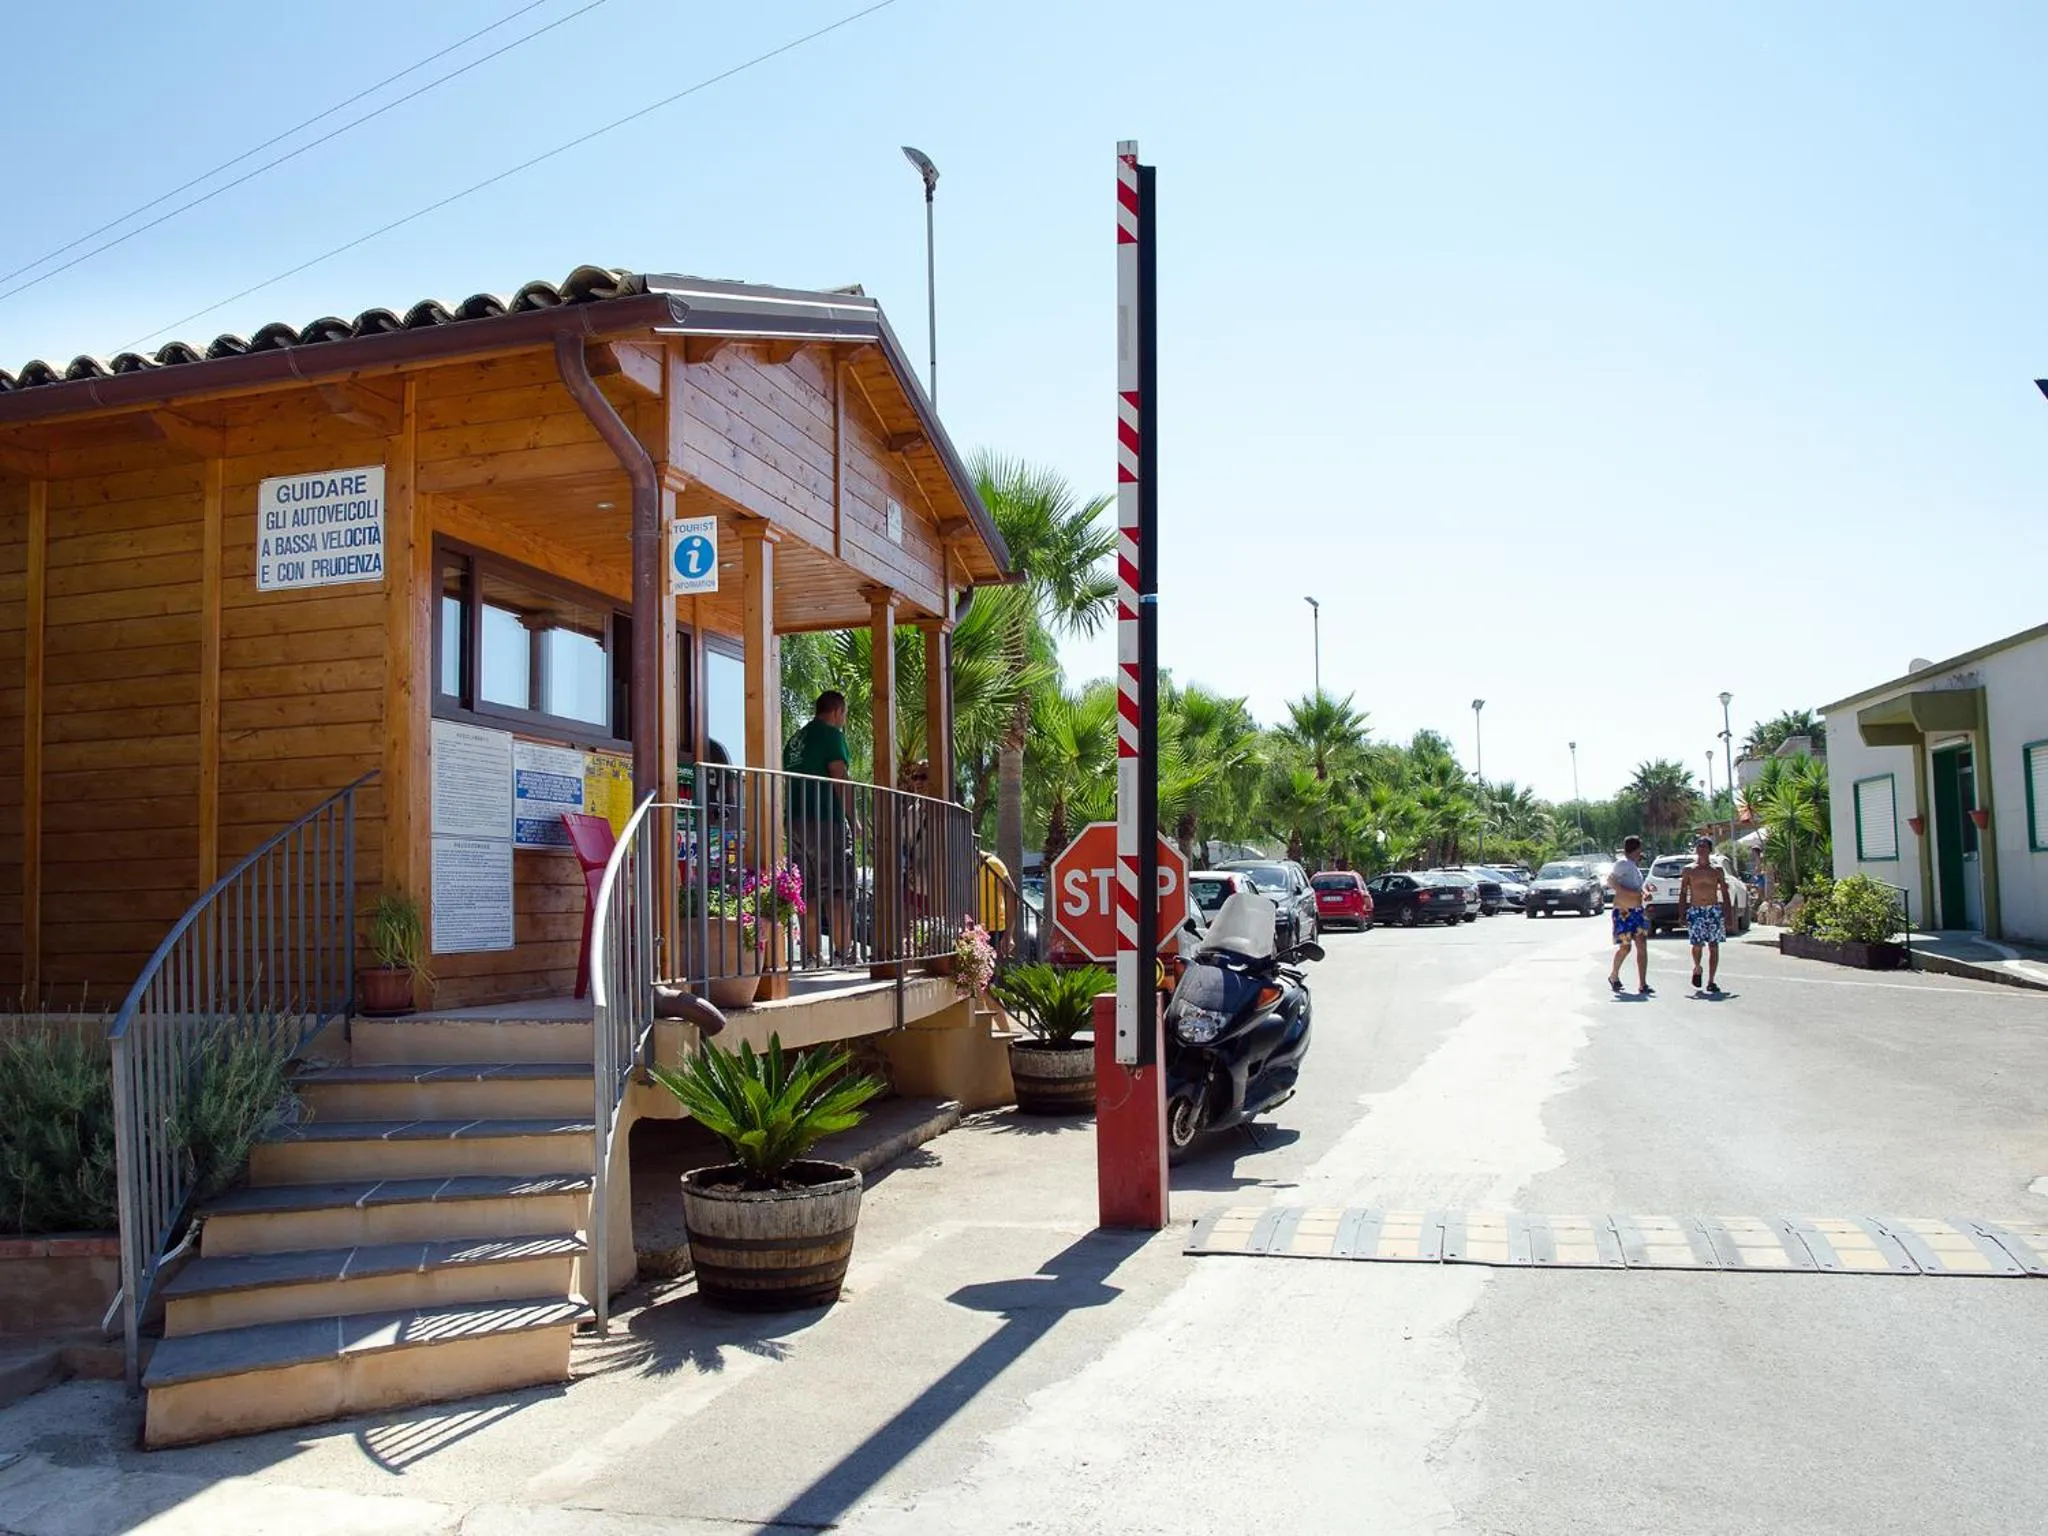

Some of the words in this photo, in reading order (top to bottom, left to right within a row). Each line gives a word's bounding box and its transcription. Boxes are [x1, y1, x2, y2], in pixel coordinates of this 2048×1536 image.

[276, 474, 367, 503] GUIDARE
[266, 511, 286, 531] GLI
[291, 499, 378, 527] AUTOVEICOLI
[673, 522, 714, 534] TOURIST
[261, 538, 271, 557] A
[275, 533, 318, 556] BASSA
[322, 522, 381, 550] VELOCITÀ
[261, 565, 270, 584] E
[277, 562, 305, 582] CON
[311, 553, 382, 578] PRUDENZA
[1063, 867, 1178, 917] STP
